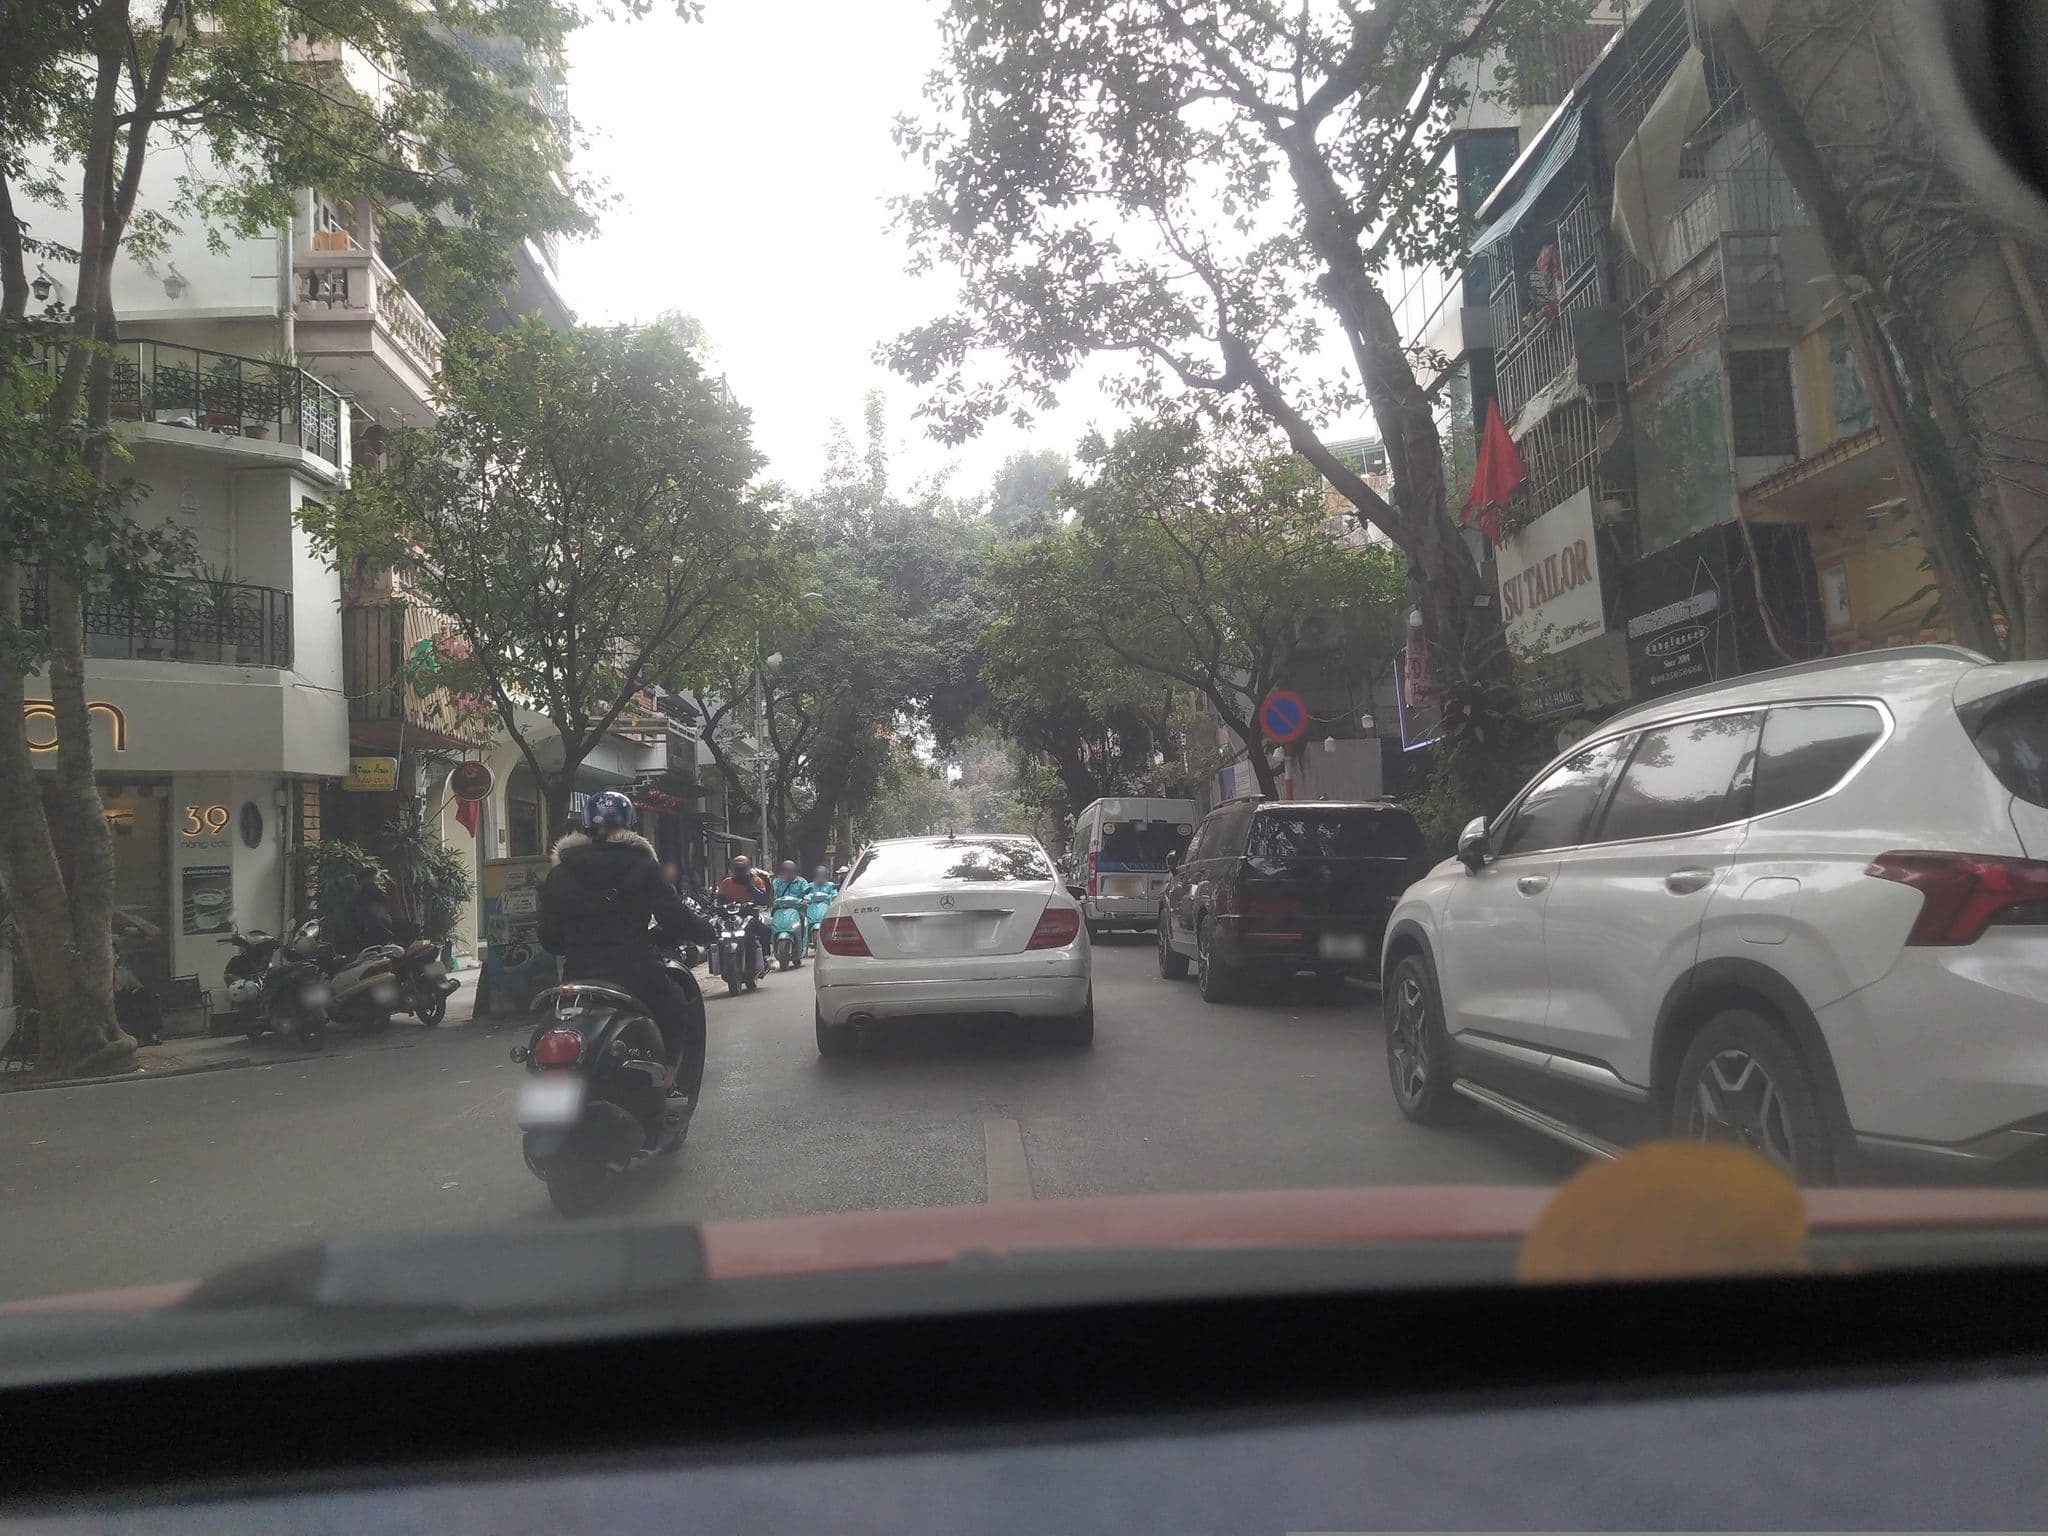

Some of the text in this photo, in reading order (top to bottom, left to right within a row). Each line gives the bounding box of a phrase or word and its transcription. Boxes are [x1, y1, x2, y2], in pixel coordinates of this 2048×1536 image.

[1502, 538, 1592, 622] SU TAILOR
[181, 804, 231, 837] 39
